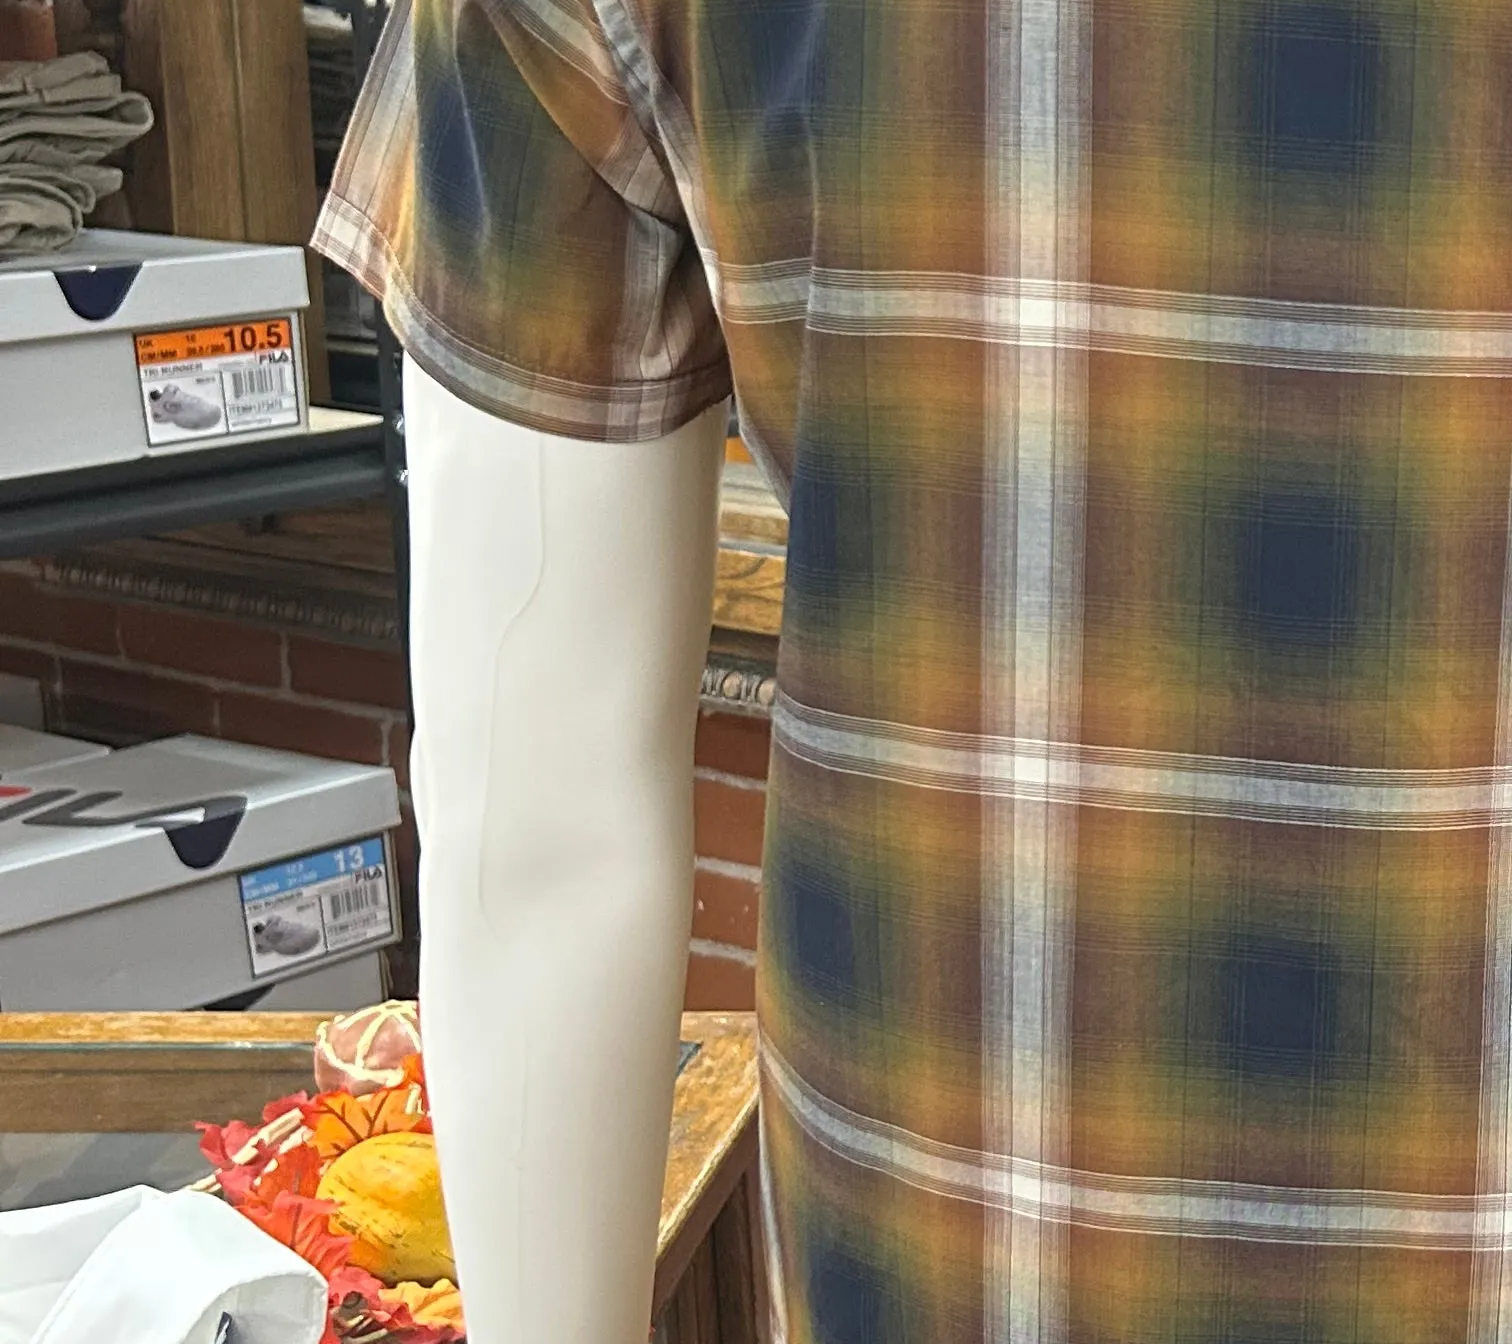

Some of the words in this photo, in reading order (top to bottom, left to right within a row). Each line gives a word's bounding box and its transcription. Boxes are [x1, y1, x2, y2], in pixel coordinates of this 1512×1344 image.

[224, 323, 283, 353] 10.5
[259, 350, 289, 365] FILA
[334, 845, 365, 873] 13
[354, 866, 383, 884] FILA
